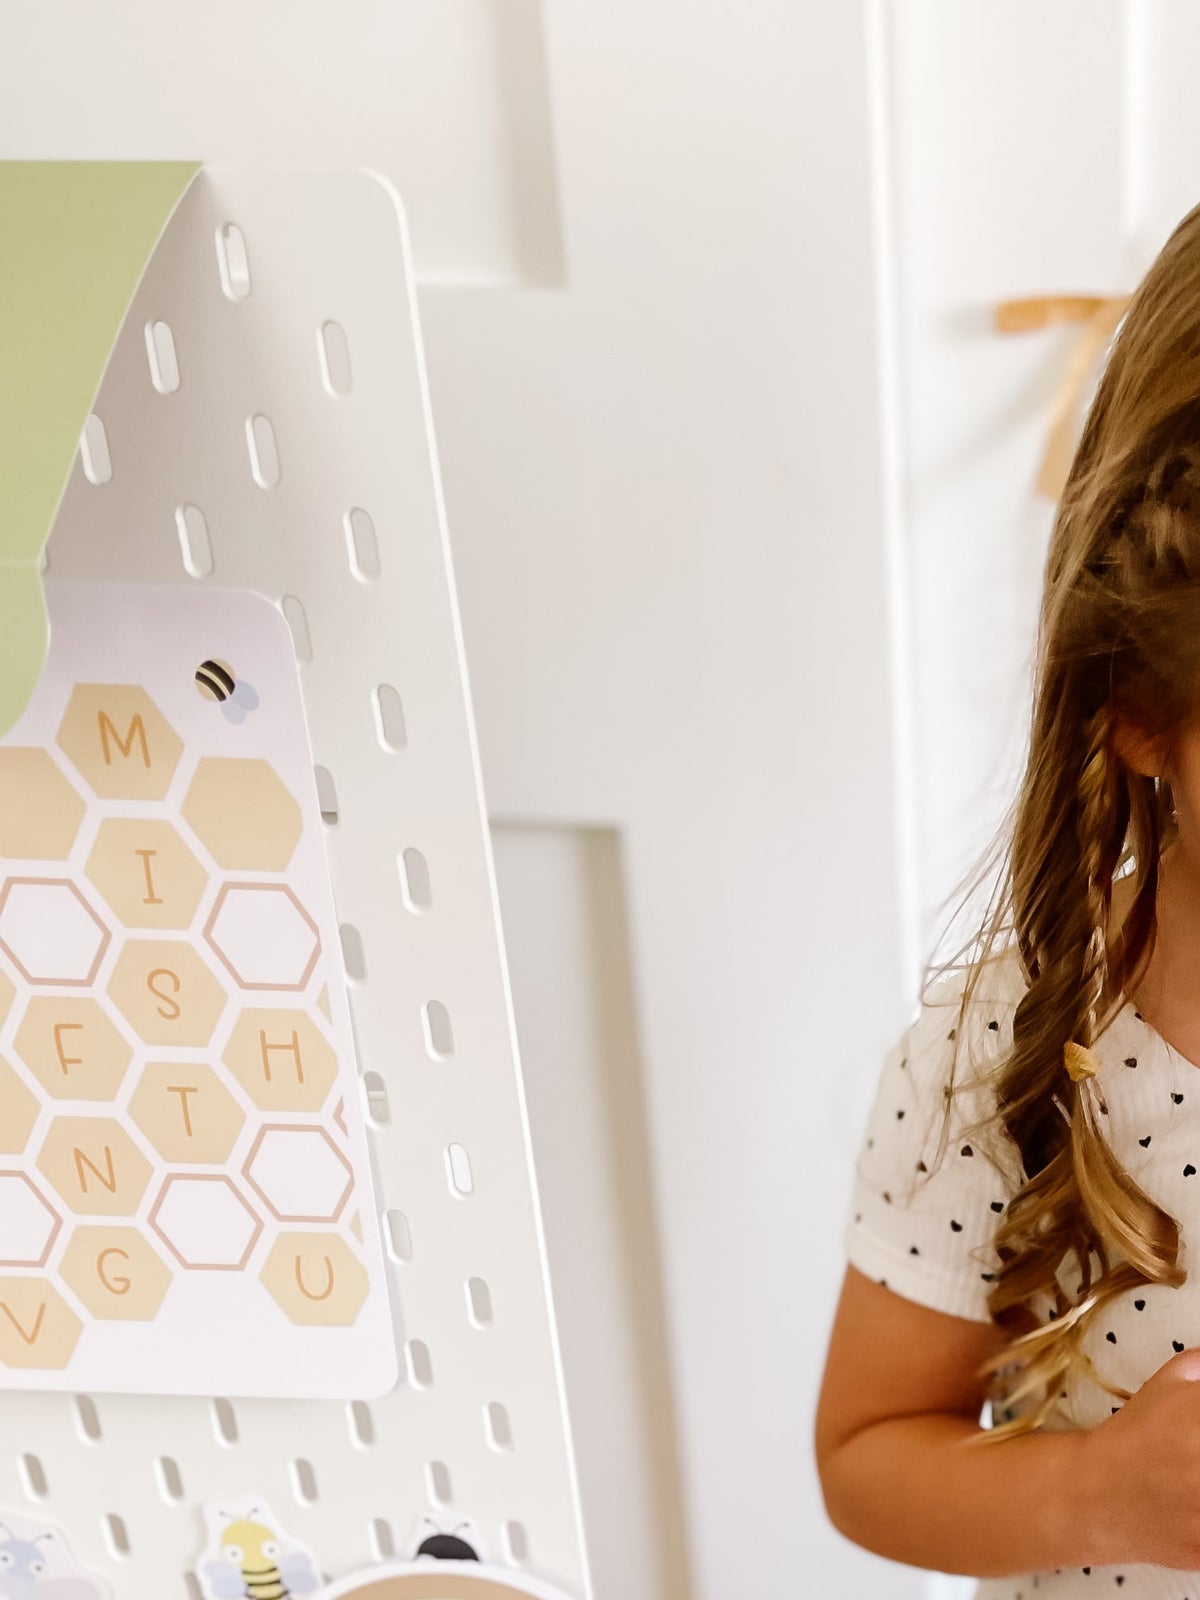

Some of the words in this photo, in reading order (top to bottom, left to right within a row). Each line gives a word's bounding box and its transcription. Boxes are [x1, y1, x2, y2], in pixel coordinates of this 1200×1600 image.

[97, 709, 151, 768] M
[134, 848, 164, 905] I
[146, 967, 181, 1021] S
[54, 1023, 84, 1075] F
[260, 1029, 305, 1084] H
[167, 1085, 199, 1138] T
[72, 1145, 117, 1194] N
[97, 1247, 131, 1296] G
[294, 1254, 335, 1302] U
[0, 1301, 47, 1346] V
